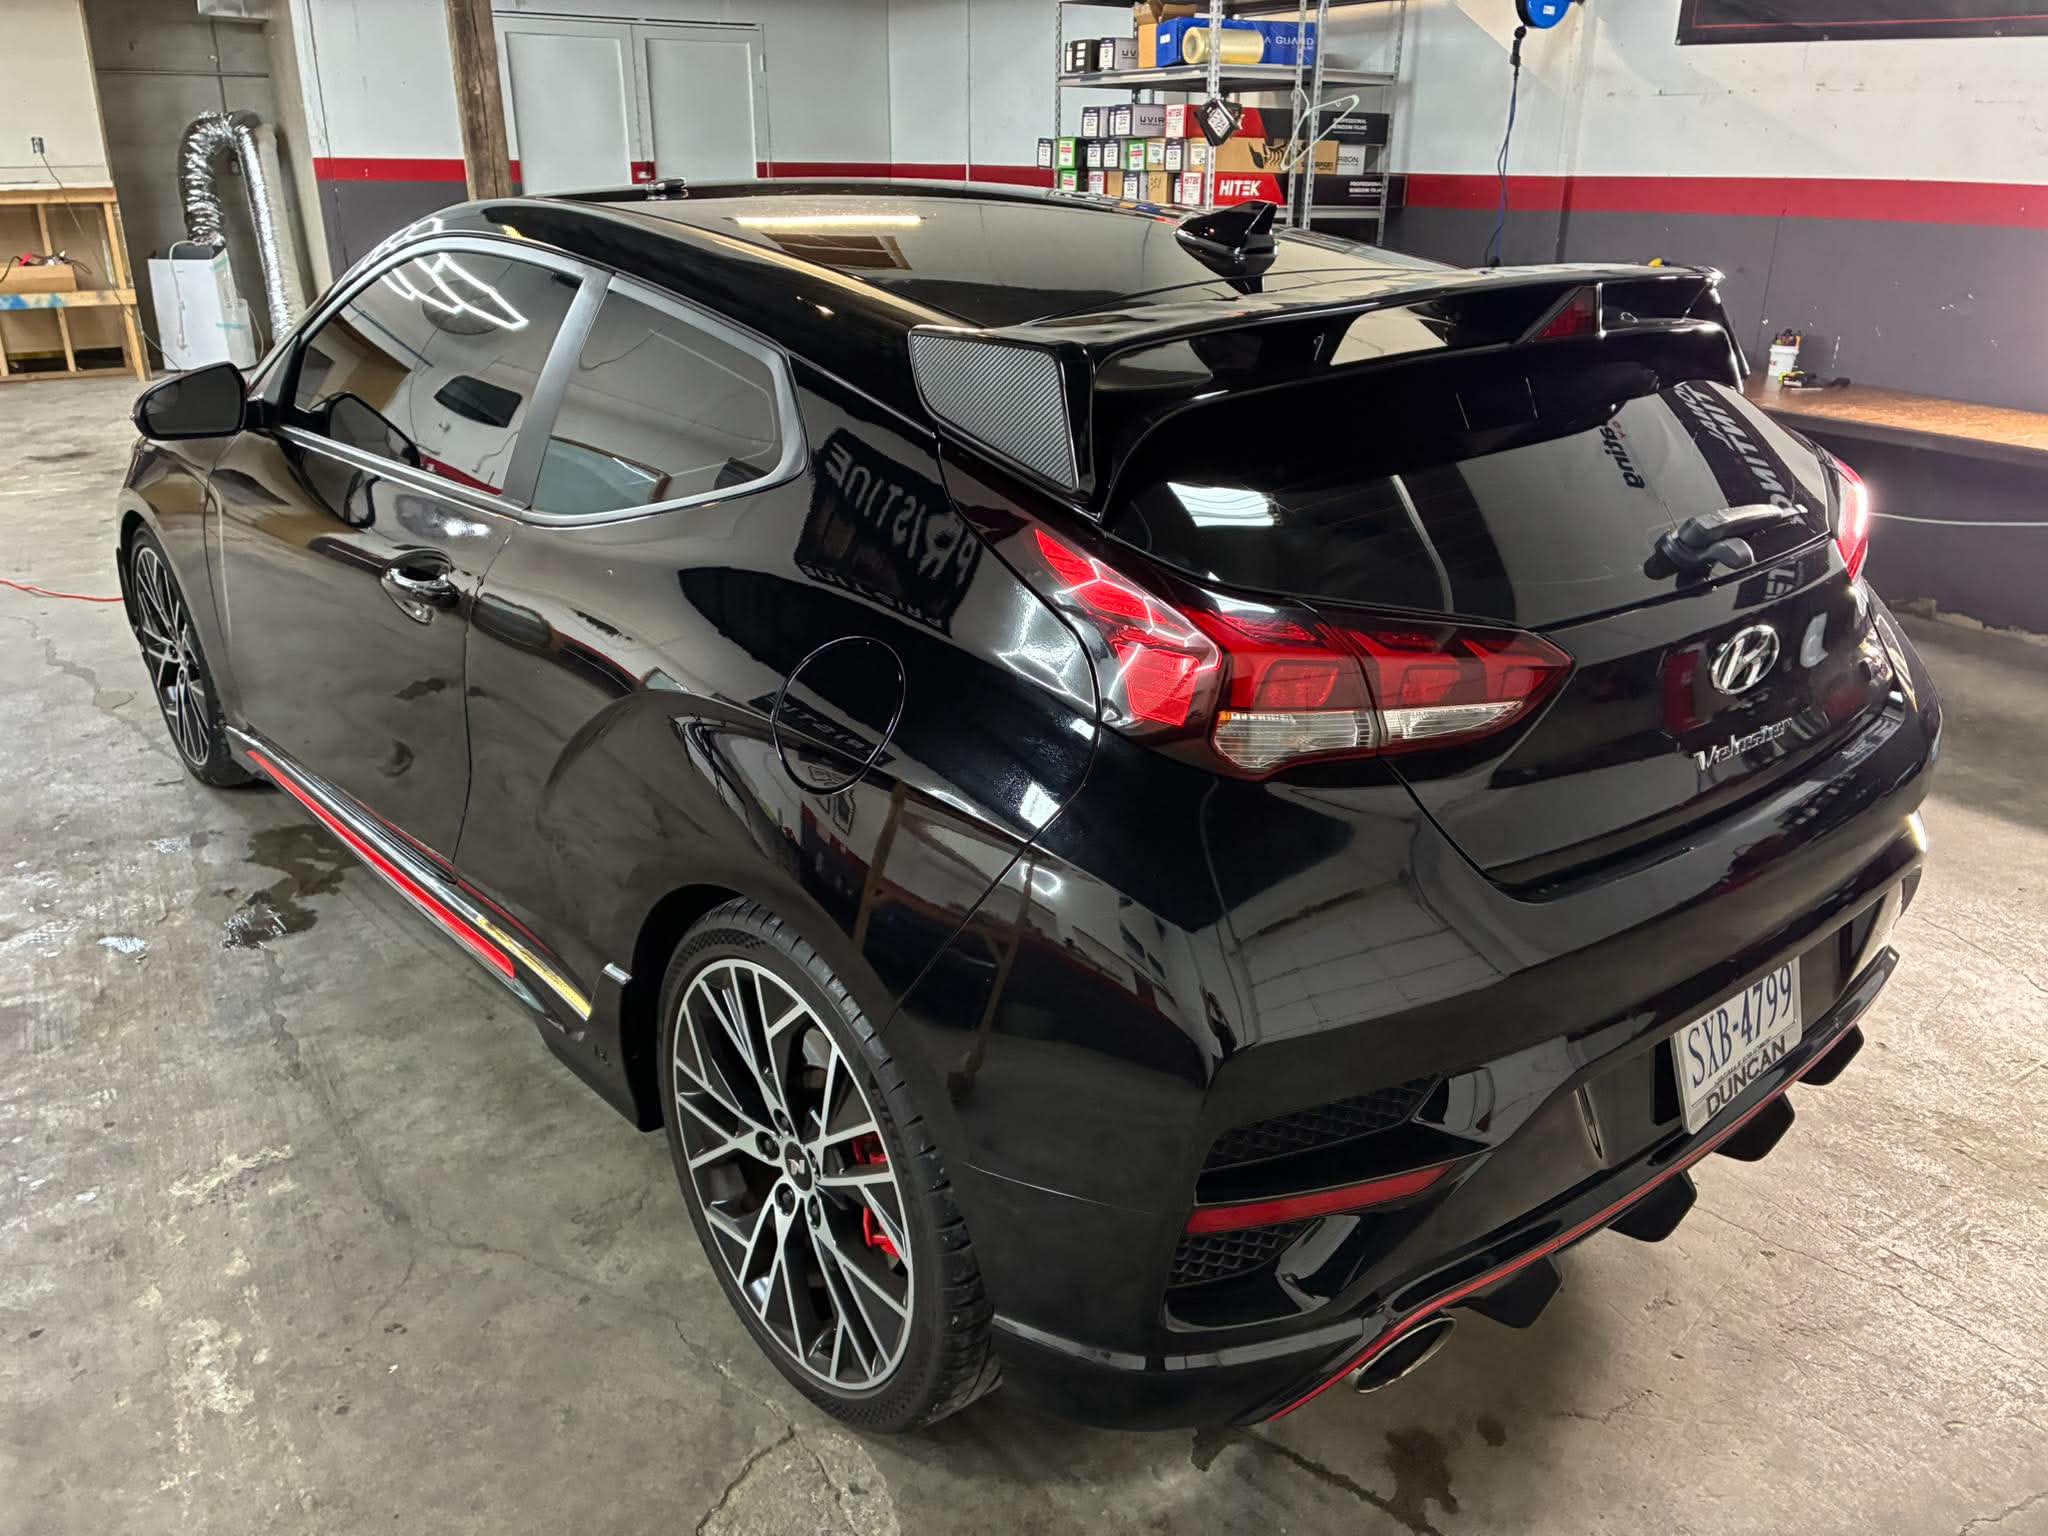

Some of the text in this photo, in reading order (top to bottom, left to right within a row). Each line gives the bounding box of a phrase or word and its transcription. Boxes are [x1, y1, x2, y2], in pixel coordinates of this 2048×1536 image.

[1275, 36, 1314, 45] GUAD
[1219, 179, 1262, 196] HITEK
[1687, 963, 1792, 1088] SXB-4799
[1706, 1035, 1787, 1118] DUNCAN
